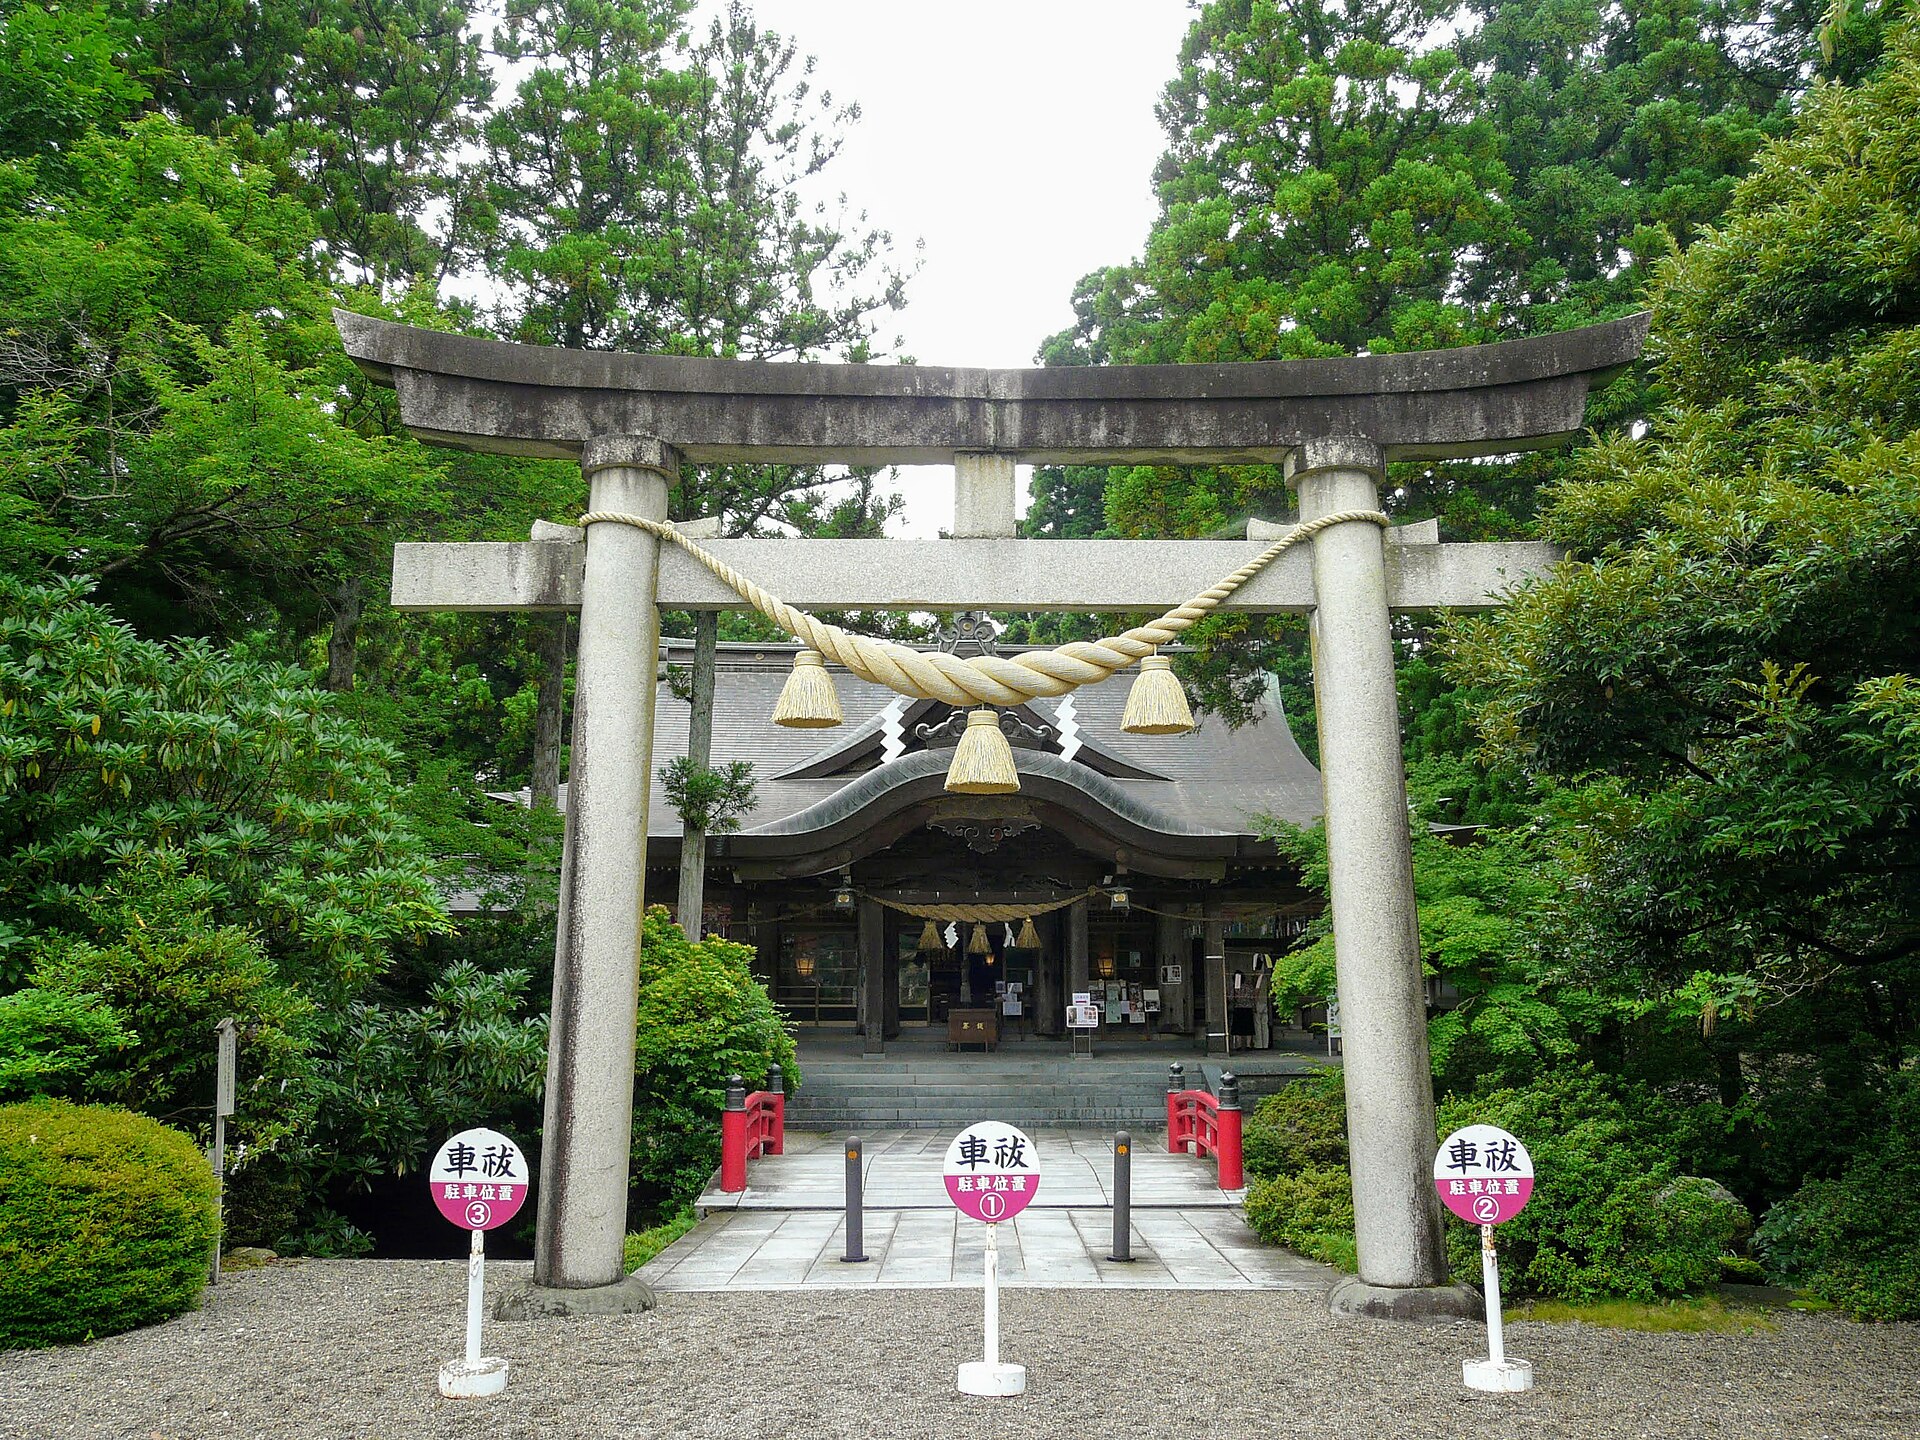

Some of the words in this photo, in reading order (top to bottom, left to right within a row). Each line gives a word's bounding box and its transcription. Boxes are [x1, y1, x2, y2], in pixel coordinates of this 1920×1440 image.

[443, 1142, 517, 1179] 車祓
[955, 1134, 1029, 1171] 車祓
[1446, 1138, 1522, 1175] 車祓
[444, 1184, 514, 1201] 駐車位置
[957, 1175, 1027, 1192] 駐車位置
[1449, 1178, 1520, 1196] 駐車位置
